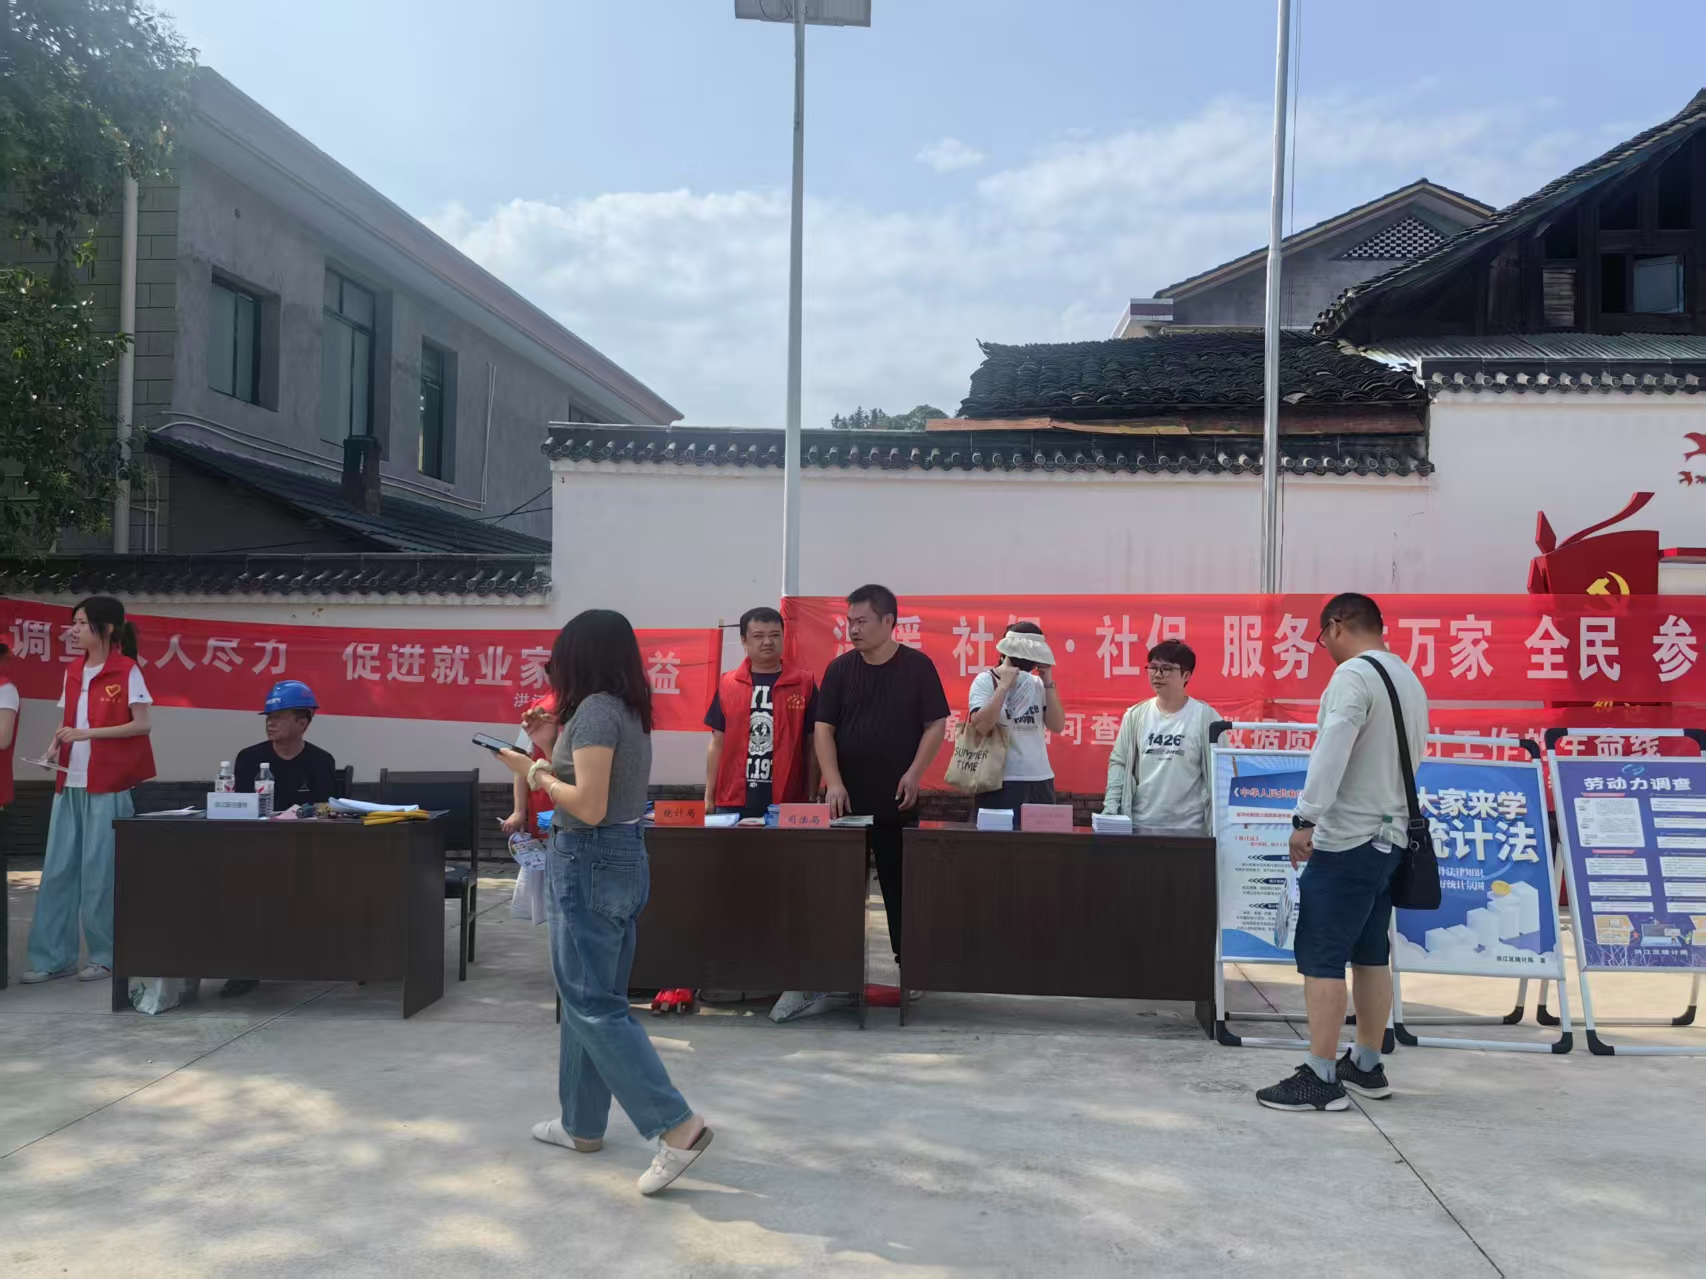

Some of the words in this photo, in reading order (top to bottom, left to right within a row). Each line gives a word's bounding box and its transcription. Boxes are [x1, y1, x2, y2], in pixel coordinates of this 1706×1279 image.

[1524, 614, 1621, 682] 全民
[1652, 614, 1699, 683] 参
[955, 746, 989, 761] SUMMER
[956, 760, 980, 773] TIME
[1583, 776, 1692, 792] 劳动力调查
[1417, 786, 1528, 820] 大家来学
[663, 807, 697, 819] 统计局
[787, 814, 820, 825] 司法局
